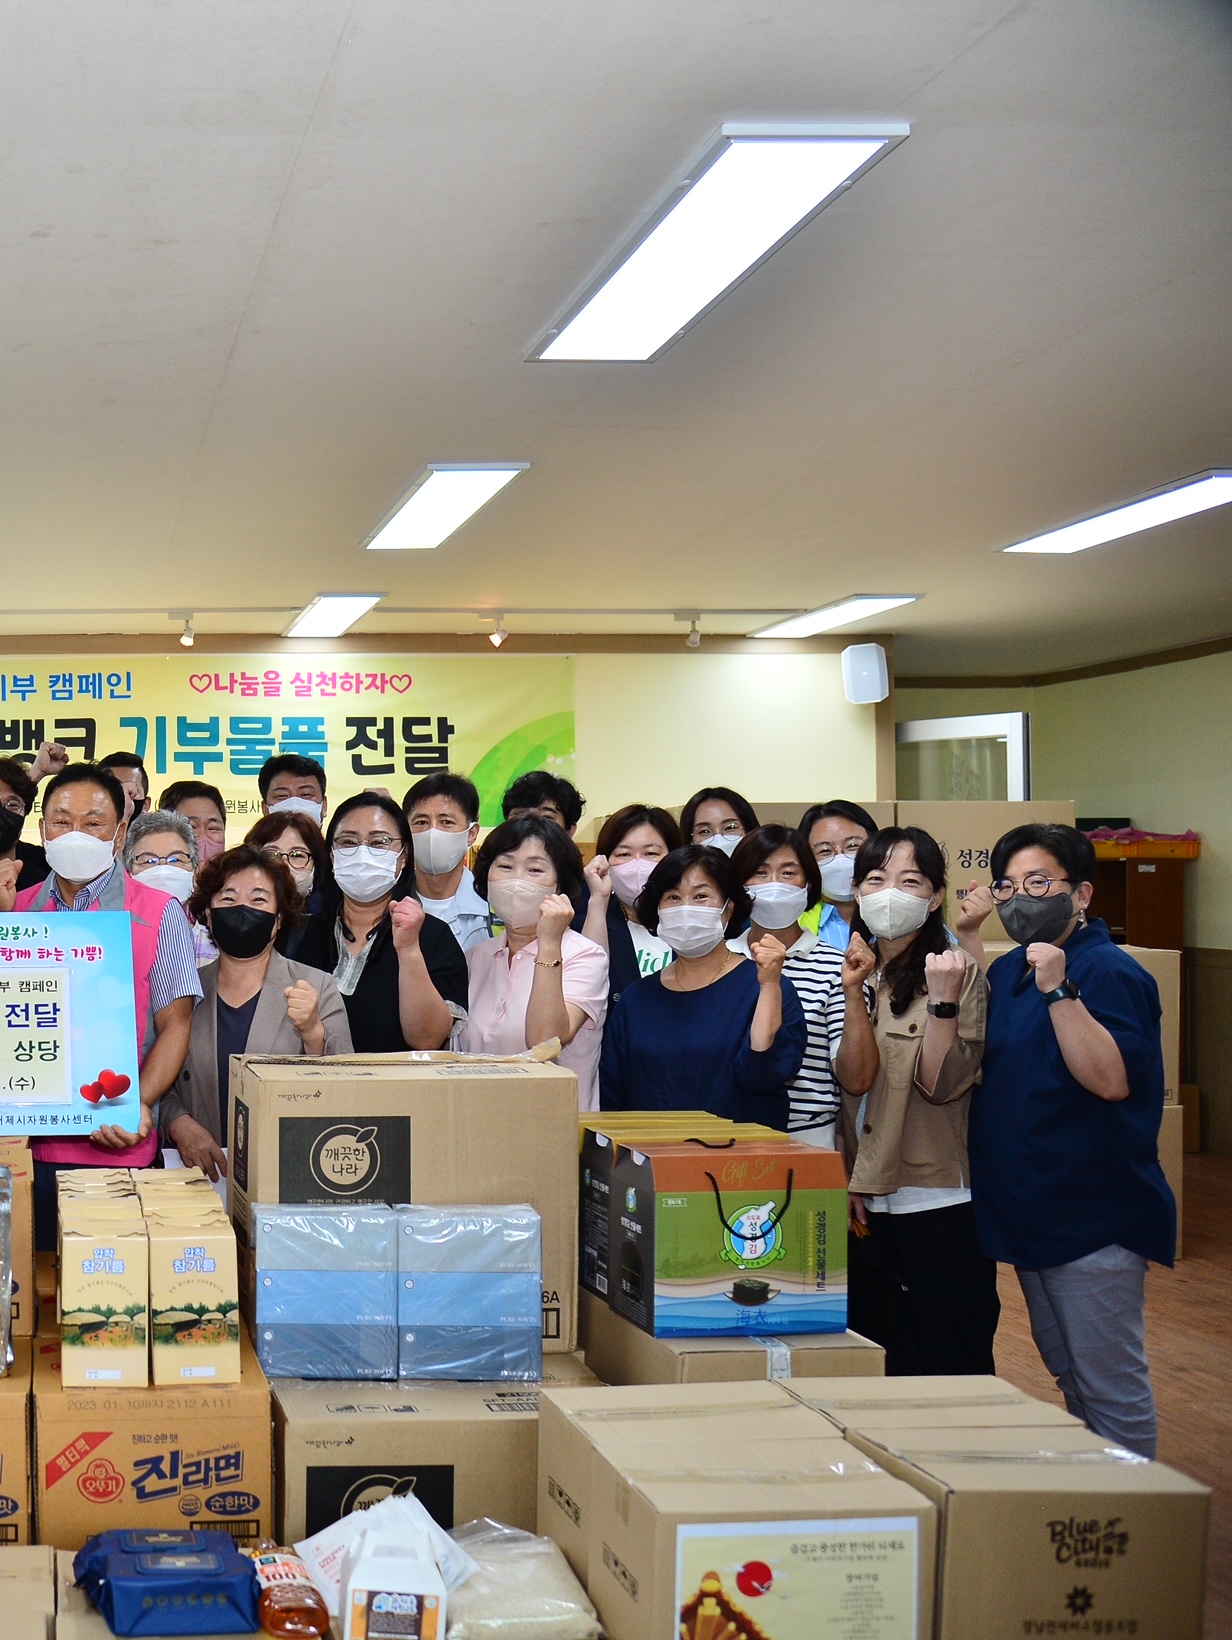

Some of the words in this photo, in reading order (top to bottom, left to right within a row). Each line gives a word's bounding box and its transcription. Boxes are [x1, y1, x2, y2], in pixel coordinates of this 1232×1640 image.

[48, 671, 132, 700] 캠페인
[214, 671, 282, 697] 나눔을
[289, 671, 388, 697] 실천하자
[119, 716, 328, 776] 기부물품
[345, 716, 455, 776] 전달
[0, 946, 31, 961] 함께
[37, 946, 64, 961] 하는
[71, 946, 103, 961] 기쁨!
[18, 980, 59, 994] 캠페인
[4, 1002, 61, 1029] 전달
[13, 1040, 61, 1062] 상당
[324, 1146, 366, 1161] 깨끗한
[332, 1164, 359, 1176] 나라
[722, 1161, 748, 1188] Gift
[752, 1158, 777, 1181] Set
[82, 1259, 125, 1274] 참기름
[173, 1258, 216, 1273] 참기름
[736, 1308, 766, 1326] 海衣
[154, 1433, 168, 1444] 순한
[55, 1438, 90, 1472] 멀티팩
[131, 1449, 245, 1503] 진라면
[85, 1480, 117, 1493] 오뚜기
[209, 1496, 255, 1511] 순한맛
[1046, 1516, 1102, 1543] Blue
[1056, 1537, 1101, 1564] City
